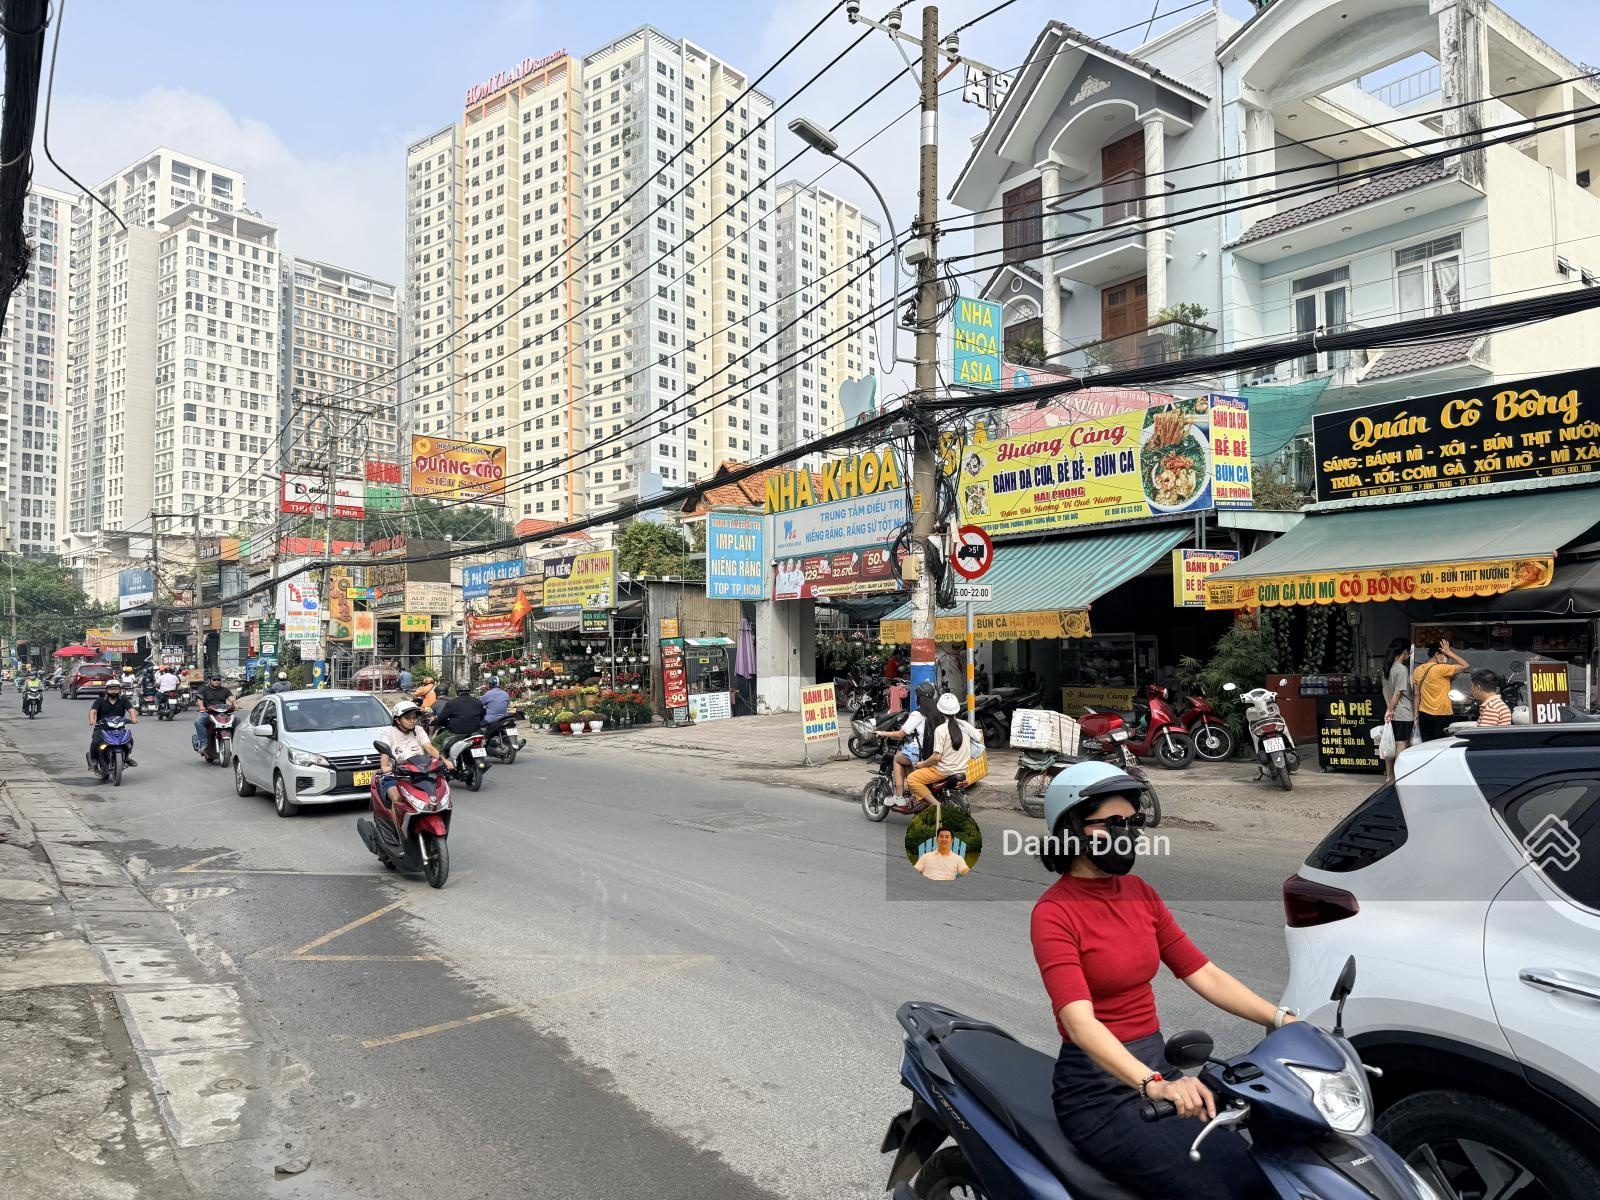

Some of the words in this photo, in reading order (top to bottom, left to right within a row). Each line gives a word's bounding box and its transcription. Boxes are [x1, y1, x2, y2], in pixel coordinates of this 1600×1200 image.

[961, 300, 992, 328] NHA
[956, 327, 997, 357] KHOA
[960, 360, 992, 385] ASIA
[1213, 408, 1228, 428] BÁNH
[1350, 412, 1432, 450] Quán
[1440, 398, 1483, 430] Cô
[1492, 388, 1582, 424] Bông
[996, 436, 1065, 462] Hương
[1069, 425, 1128, 451] Cảng
[1323, 456, 1362, 472] SÁNG:
[1366, 450, 1402, 467] BÁNH
[1406, 444, 1422, 462] MÌ
[1439, 439, 1466, 458] XÔI
[1483, 432, 1513, 452] BÚN
[1521, 430, 1552, 448] THỊT
[416, 453, 470, 476] QUẢNG
[476, 459, 502, 480] CÁO
[993, 468, 1017, 494] BÁNH
[1018, 470, 1032, 489] ĐA
[1094, 451, 1116, 478] BÚN
[1119, 447, 1135, 473] CÁ
[1215, 460, 1235, 482] BÚN
[1236, 464, 1248, 483] CÁ
[1330, 473, 1362, 490] TRƯA
[1373, 466, 1400, 484] TỐI:
[1402, 464, 1437, 480] CƠM
[1442, 458, 1466, 476] GÀ
[1474, 452, 1501, 472] XỐI
[1506, 450, 1533, 469] MỠ
[1551, 445, 1570, 464] MÌ
[1574, 442, 1600, 460] XÀ
[764, 468, 814, 514] NHA
[821, 447, 900, 503] KHOA
[820, 508, 846, 523] TRUNG
[848, 504, 864, 516] TÂM
[866, 498, 886, 514] ĐIỀU
[1092, 496, 1122, 505] Hương
[878, 514, 893, 531] TỐT
[716, 532, 756, 551] IMPLANT
[740, 558, 760, 576] RĂNG
[804, 570, 818, 580] 129
[1420, 572, 1434, 584] XÔI
[1441, 568, 1458, 582] BÚN
[1460, 570, 1478, 584] THỊT
[1480, 566, 1510, 580] NƯỚNG
[714, 582, 730, 595] TOP
[732, 583, 760, 595] TP.HCM
[1258, 582, 1280, 601] CƠM
[1282, 580, 1296, 600] GÀ
[1299, 576, 1316, 599] XỐI
[1319, 578, 1336, 598] MỠ
[1340, 574, 1362, 598] CÔ
[1366, 570, 1416, 596] BÔNG
[896, 624, 912, 632] BÁN
[977, 618, 994, 629] BÚN
[996, 616, 1008, 628] CÁ
[1532, 669, 1556, 692] BÁNH
[1556, 668, 1568, 692] MÌ
[1330, 700, 1346, 716] CÀ
[1349, 699, 1372, 716] PHÊ
[1321, 726, 1330, 736] CÀ
[1330, 727, 1342, 736] PHÊ
[1321, 737, 1330, 745] CÀ
[1331, 737, 1342, 745] PHÊ
